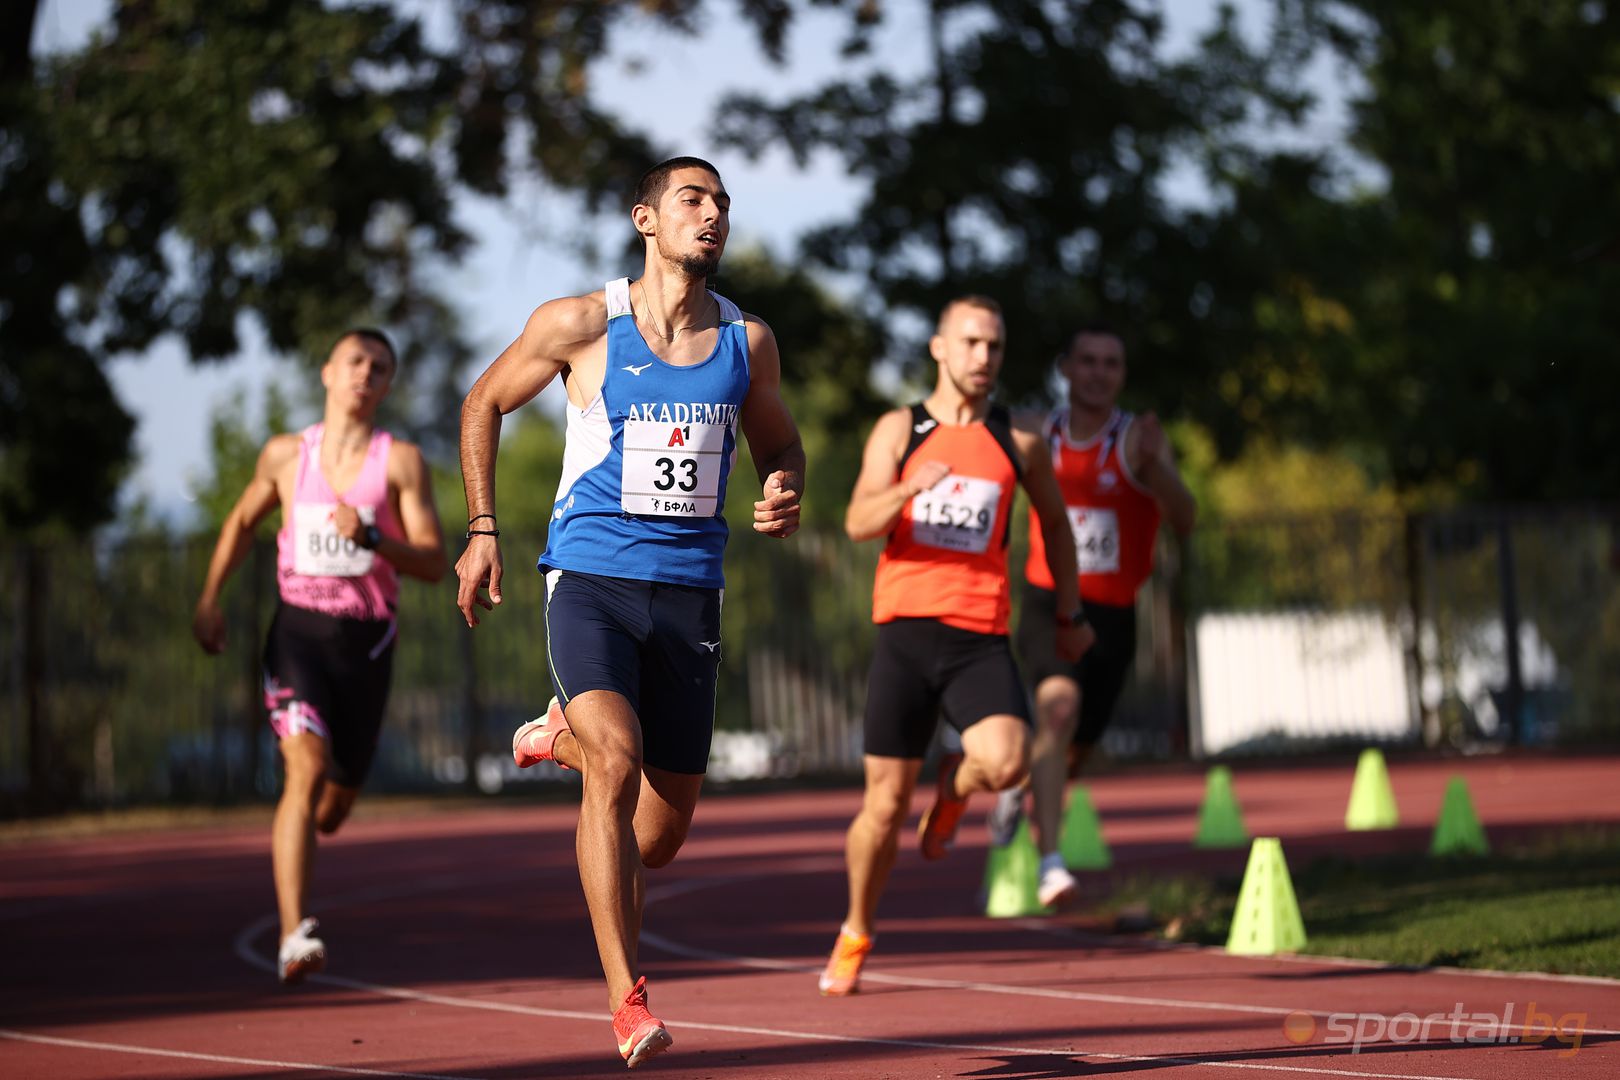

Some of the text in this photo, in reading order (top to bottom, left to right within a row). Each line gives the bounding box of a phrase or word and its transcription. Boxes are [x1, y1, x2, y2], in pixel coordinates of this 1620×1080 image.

[629, 402, 737, 425] AKADEMIK
[667, 425, 690, 447] A1
[653, 457, 698, 492] 33
[664, 501, 696, 513] БФЛА
[923, 502, 990, 534] 1529
